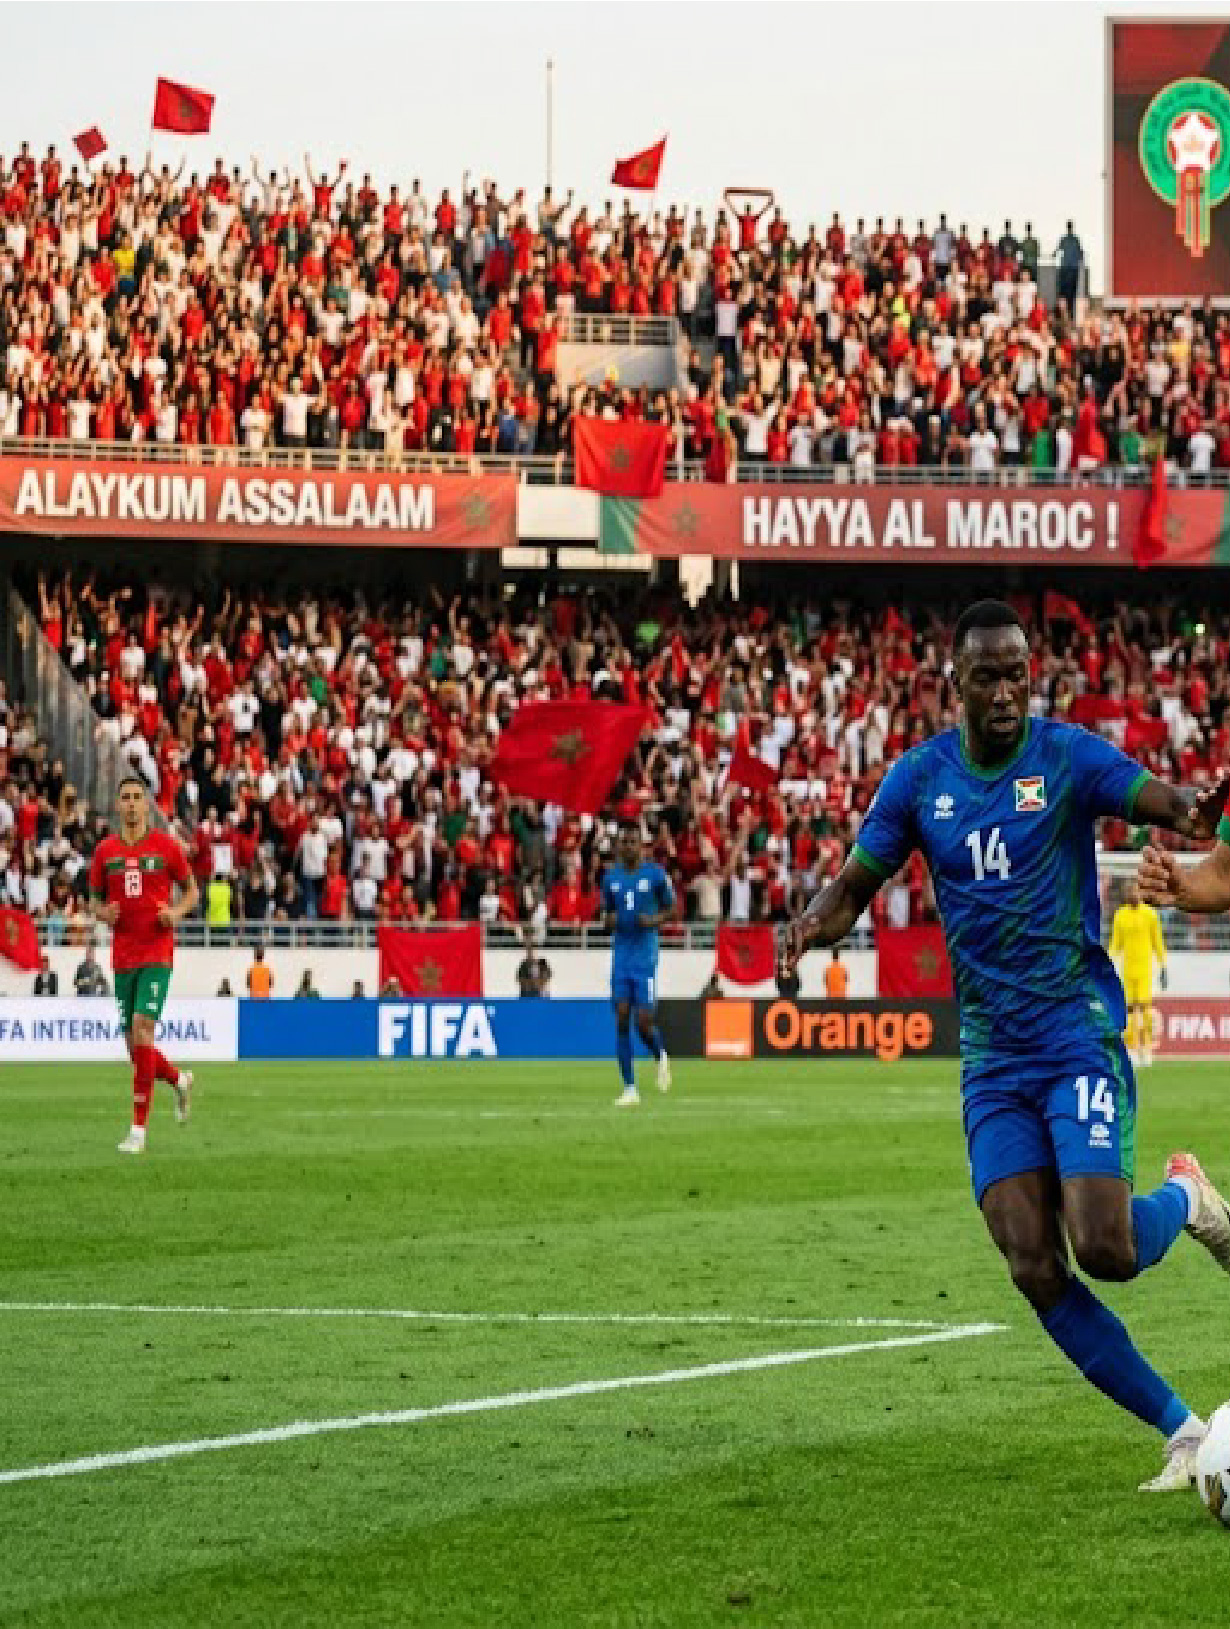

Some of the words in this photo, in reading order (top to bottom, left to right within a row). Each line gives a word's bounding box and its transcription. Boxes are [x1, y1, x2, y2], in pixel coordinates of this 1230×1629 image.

[14, 467, 207, 522] ALAYKUM
[216, 477, 436, 531] ASSALAAM
[742, 495, 875, 548] HAYYA
[882, 498, 937, 549] AL
[946, 499, 1096, 551] MAROC
[1106, 500, 1120, 552] !
[965, 826, 1011, 881] 14
[0, 1018, 26, 1042] FA
[378, 1003, 498, 1057] FIFA
[764, 998, 934, 1061] Orange
[1168, 1015, 1216, 1042] FIFA
[1073, 1075, 1116, 1123] 14
